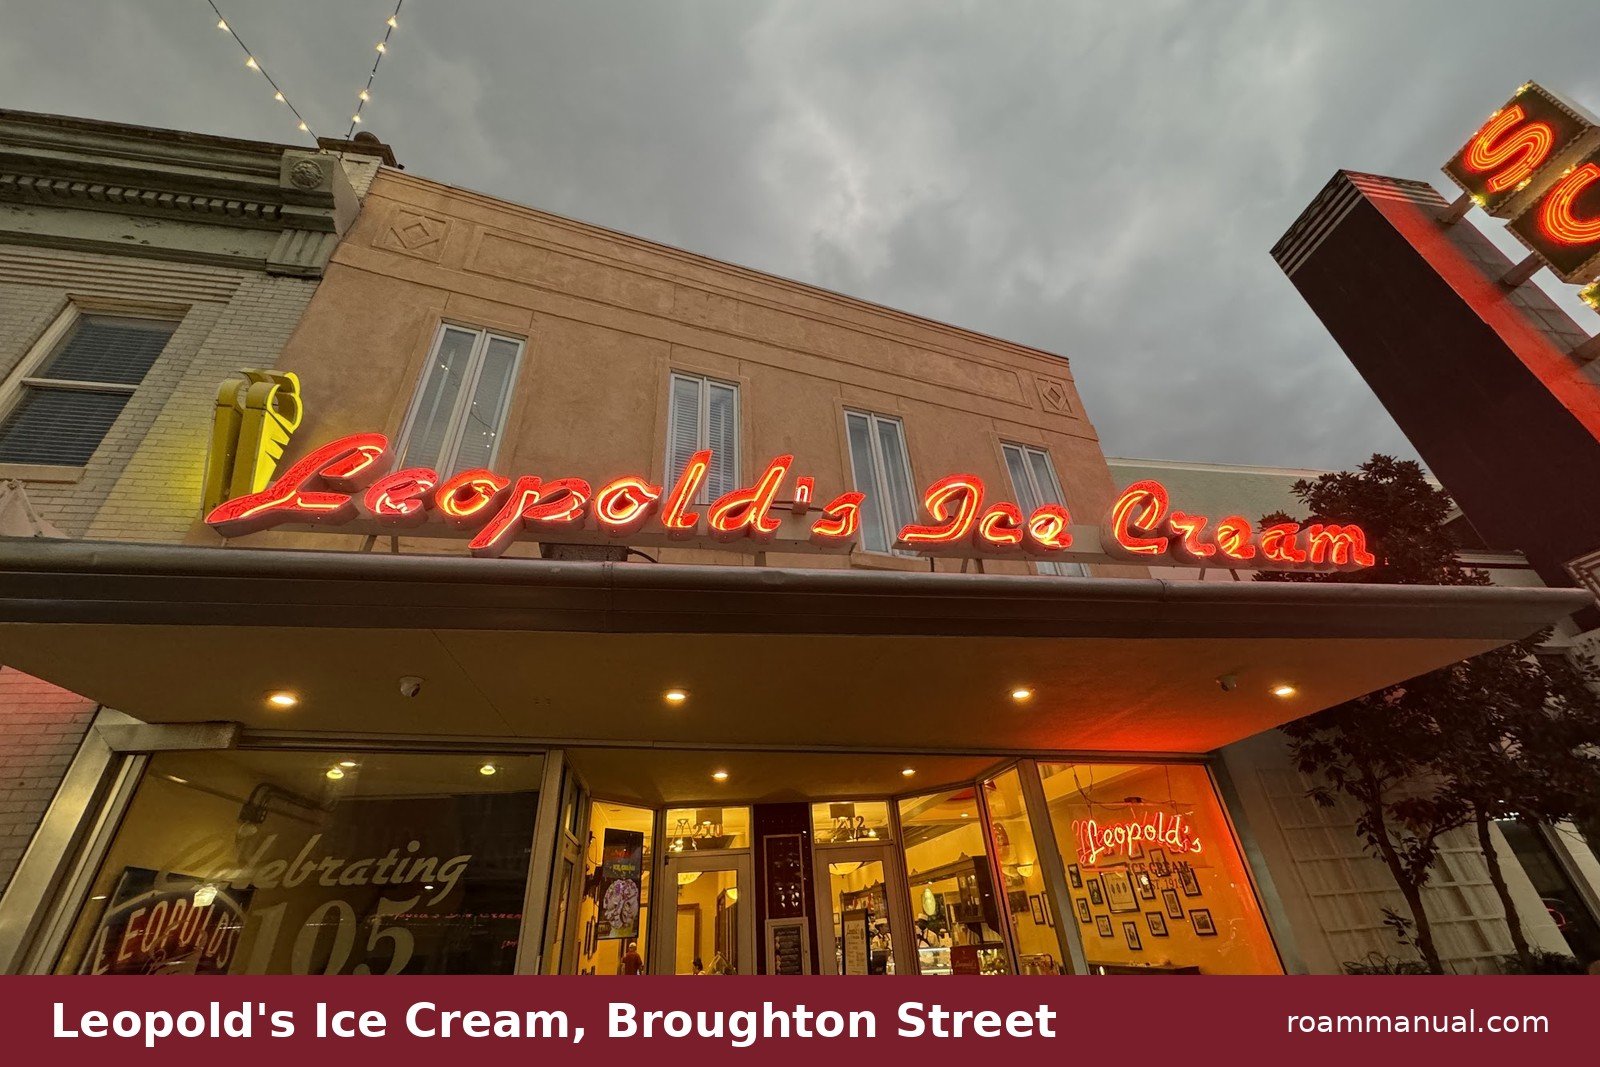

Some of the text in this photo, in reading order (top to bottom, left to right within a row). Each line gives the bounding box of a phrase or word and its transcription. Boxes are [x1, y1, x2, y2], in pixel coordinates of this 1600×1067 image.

[203, 431, 1376, 568] Leopold's Ice Cream
[1087, 811, 1202, 864] Leopold's
